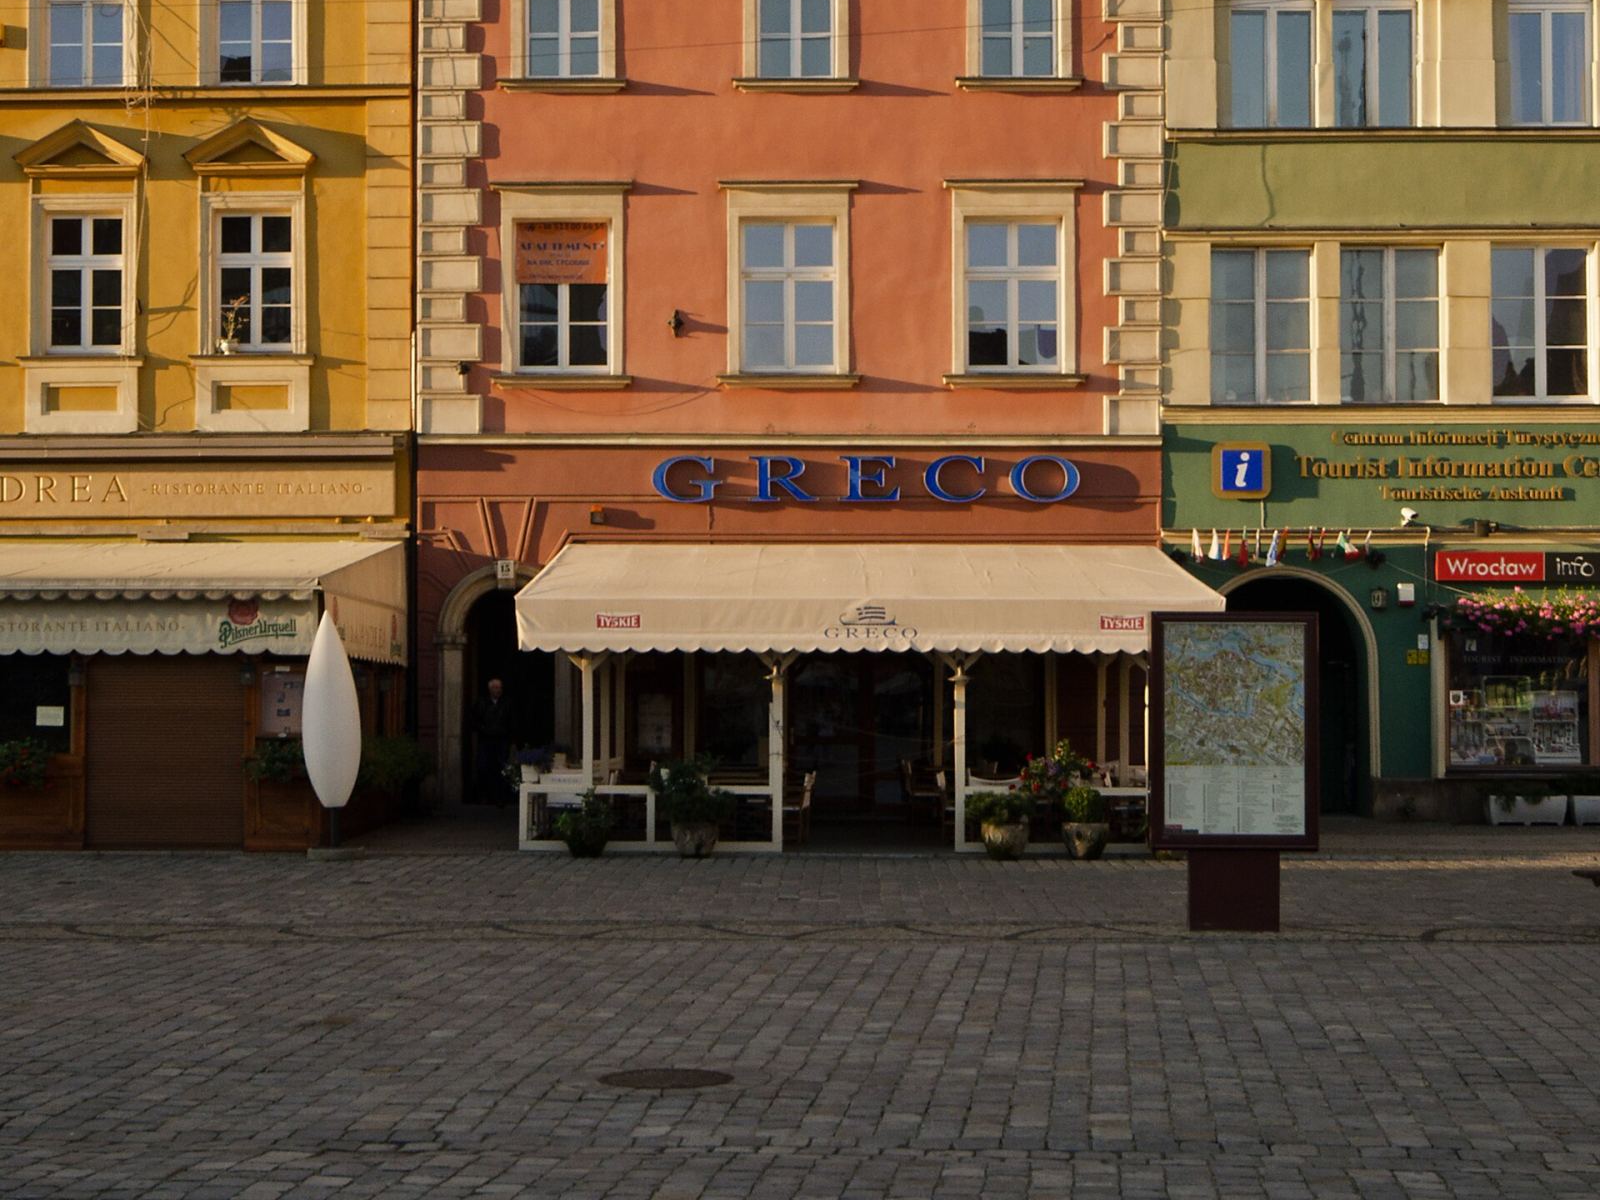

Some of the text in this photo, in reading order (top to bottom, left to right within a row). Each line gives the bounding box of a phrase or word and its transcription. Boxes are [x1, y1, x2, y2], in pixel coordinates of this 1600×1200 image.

[1330, 430, 1404, 444] Centrum
[1409, 429, 1498, 448] Informacji
[1295, 455, 1600, 478] Tourist Information Ce
[0, 475, 128, 502] DREA
[652, 455, 1080, 502] GRECO
[1378, 484, 1564, 500] Touristische Auskunft
[1446, 556, 1596, 577] Wrocław info
[600, 616, 638, 627] TYSKIE
[1103, 617, 1142, 628] TYSKIE
[218, 618, 296, 648] Pilsner Urquell
[824, 627, 918, 639] GRECO
